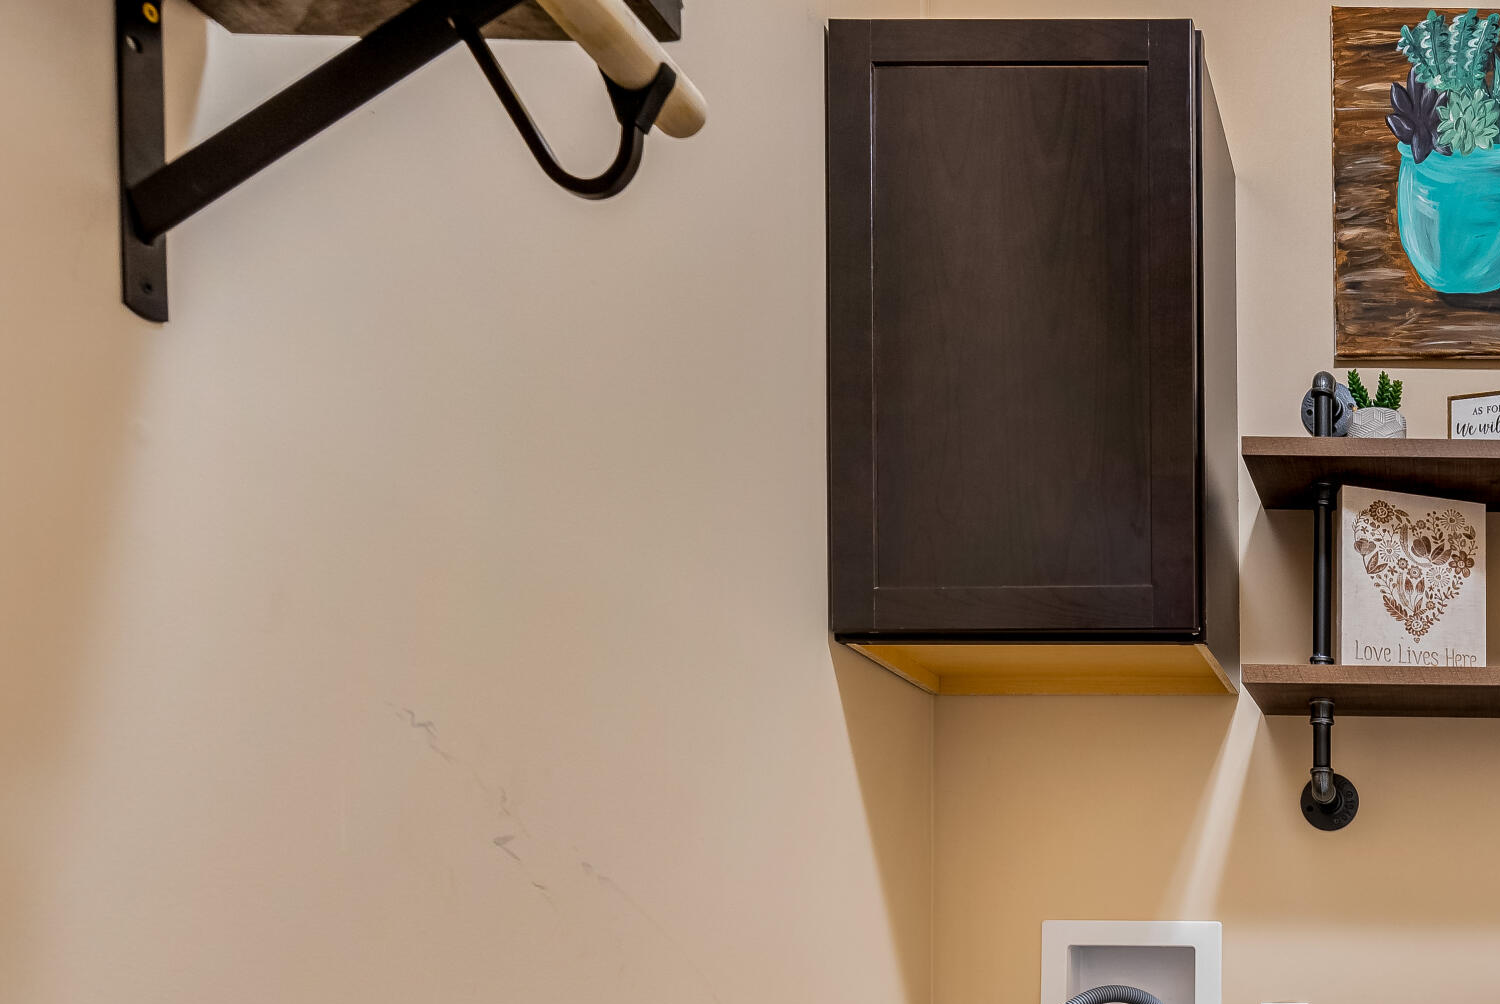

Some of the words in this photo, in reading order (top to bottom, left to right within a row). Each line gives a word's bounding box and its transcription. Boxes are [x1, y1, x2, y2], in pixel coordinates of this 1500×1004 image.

[1472, 406, 1483, 415] AS
[1355, 639, 1392, 663] Love
[1398, 643, 1439, 666] Lives
[1445, 647, 1478, 667] Here
